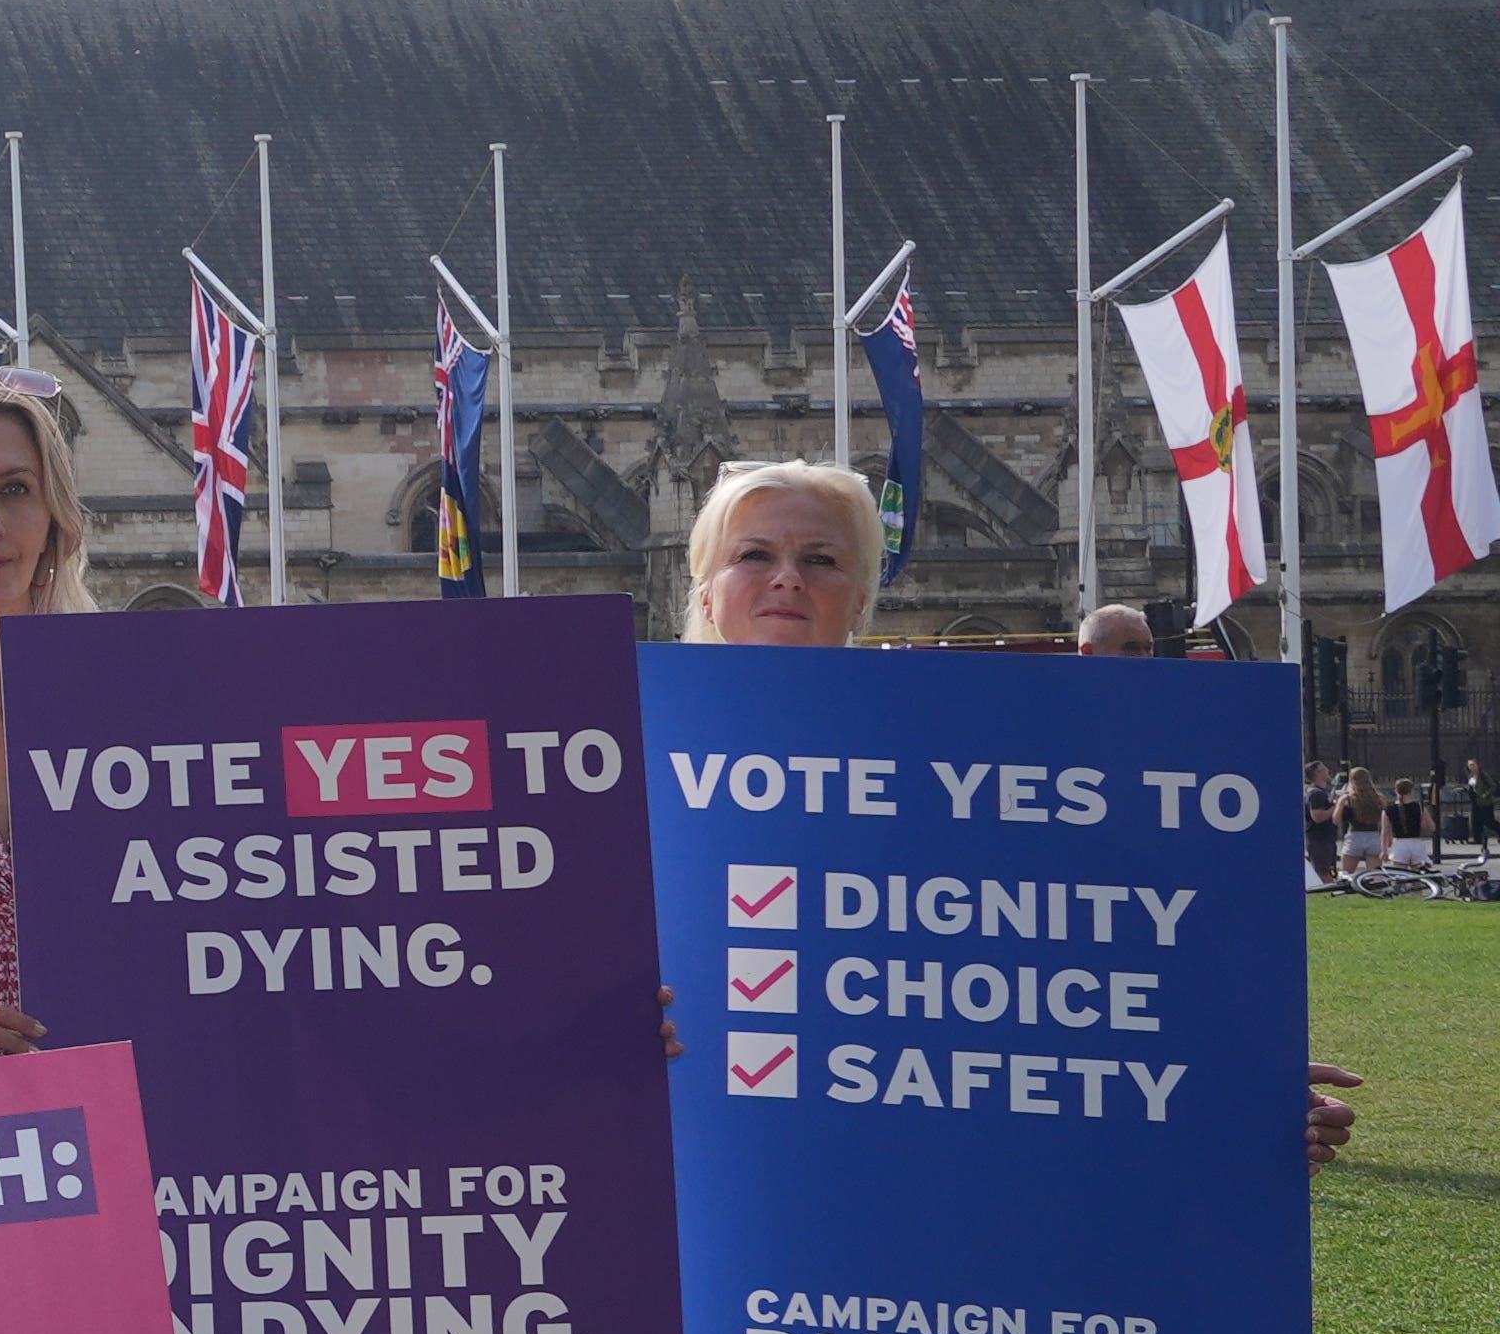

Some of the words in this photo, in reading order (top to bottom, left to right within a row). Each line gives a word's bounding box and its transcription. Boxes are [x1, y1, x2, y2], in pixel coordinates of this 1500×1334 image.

[29, 742, 264, 811] VOTE
[295, 735, 473, 801] YES
[507, 729, 621, 794] TO
[669, 753, 896, 815] VOTE
[930, 762, 1107, 825] YES
[1143, 771, 1259, 832] TO
[112, 827, 554, 902] ASSISTED
[825, 872, 1196, 945] DIGNITY
[187, 923, 492, 994] DYING.
[826, 957, 1159, 1031] CHOICE
[827, 1044, 1188, 1121] SAFETY
[154, 1169, 421, 1216] AMPAIGN
[449, 1165, 567, 1207] FOR
